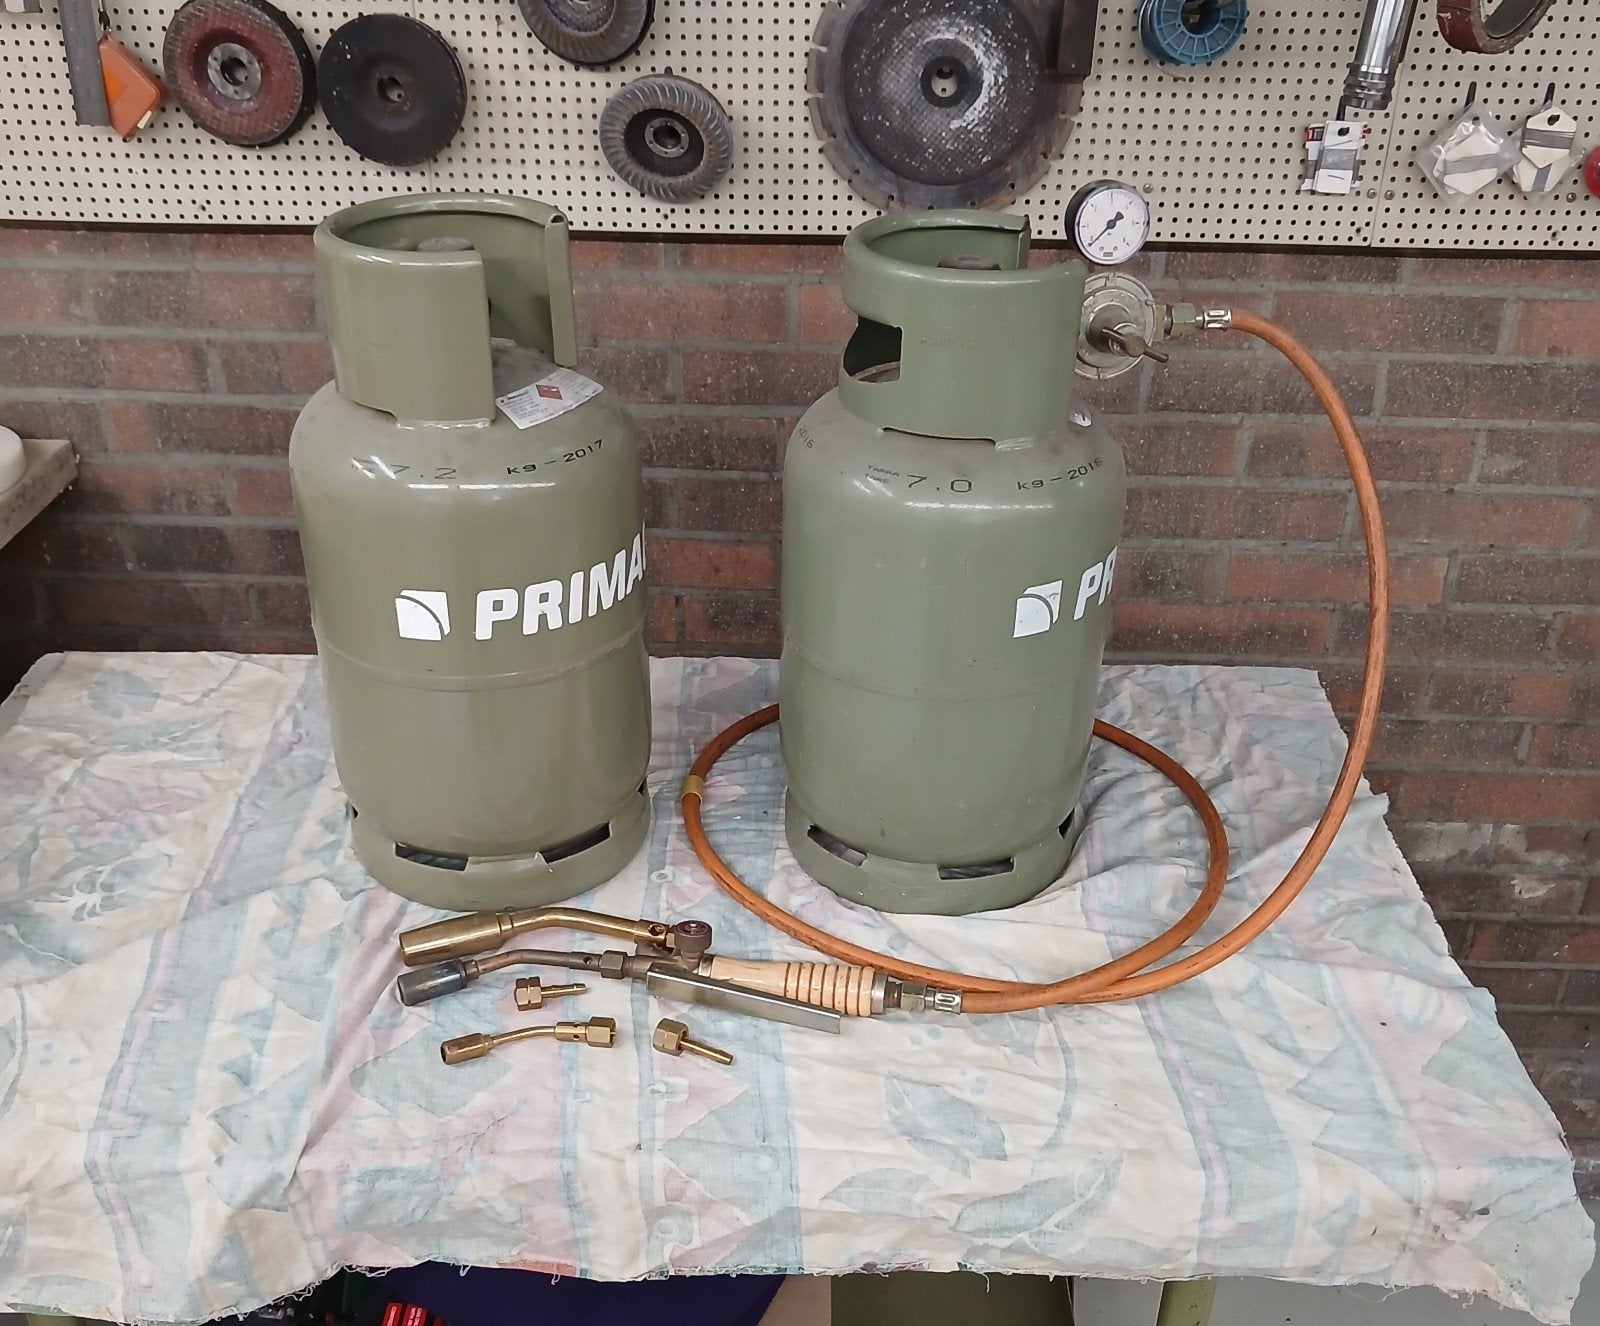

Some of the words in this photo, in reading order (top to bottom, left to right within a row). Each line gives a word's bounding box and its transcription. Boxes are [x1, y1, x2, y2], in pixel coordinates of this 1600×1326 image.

[562, 438, 603, 463] 2017
[907, 474, 972, 493] 7.0
[1067, 457, 1103, 480] 2016
[474, 520, 648, 641] PRIMA
